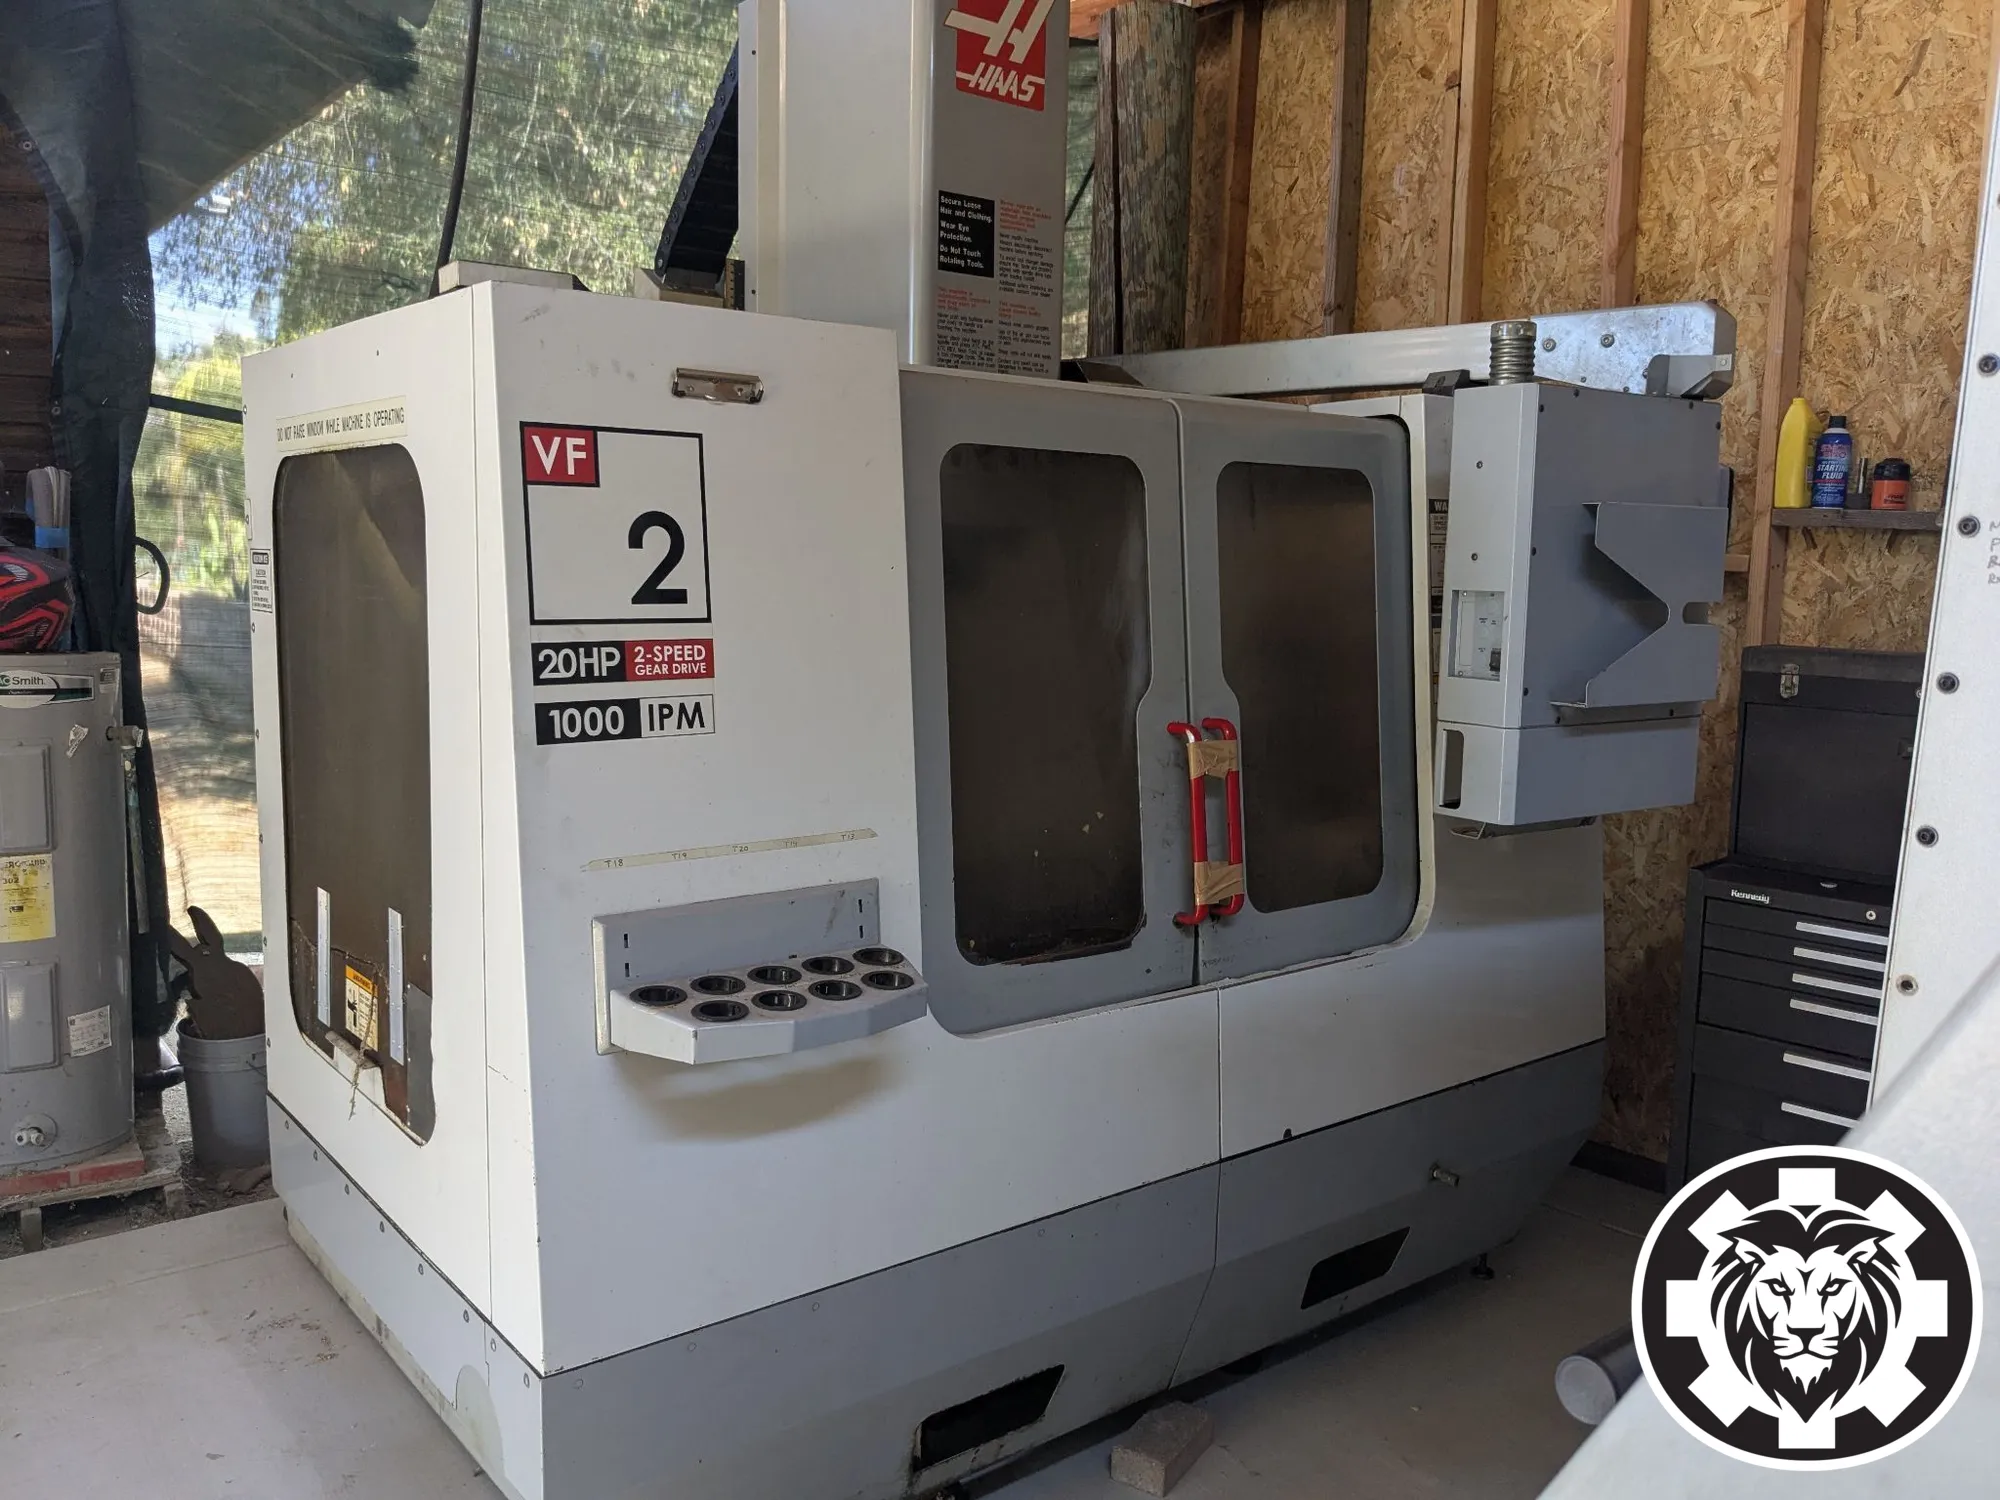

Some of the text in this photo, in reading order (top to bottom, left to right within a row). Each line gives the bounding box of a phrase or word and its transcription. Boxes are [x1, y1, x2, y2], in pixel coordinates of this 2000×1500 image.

[956, 62, 1045, 102] HAAS
[940, 195, 981, 210] Secure Loose
[940, 206, 952, 214] Hair
[954, 210, 965, 218] and
[940, 220, 970, 233] Wear Eye
[939, 244, 981, 258] Do Not Touch
[939, 254, 965, 267] Rotating
[284, 426, 292, 441] NOT
[293, 424, 305, 440] RAISE
[306, 420, 324, 437] WINDOW
[325, 417, 340, 435] WHILE
[341, 413, 363, 432] MACHINE
[365, 412, 371, 428] IS
[373, 407, 405, 427] OPERATING
[531, 435, 587, 476] VF
[1821, 472, 1844, 480] FLUID
[628, 510, 688, 605] 2
[538, 645, 706, 680] 20HP 2-SPEED
[635, 660, 707, 676] GEAR DRIVE
[12, 675, 44, 686] Smith
[549, 702, 705, 739] 1000 IPM
[604, 858, 624, 868] T18
[671, 852, 687, 860] T19
[841, 833, 856, 841] T13
[1731, 889, 1770, 904] Kennedy
